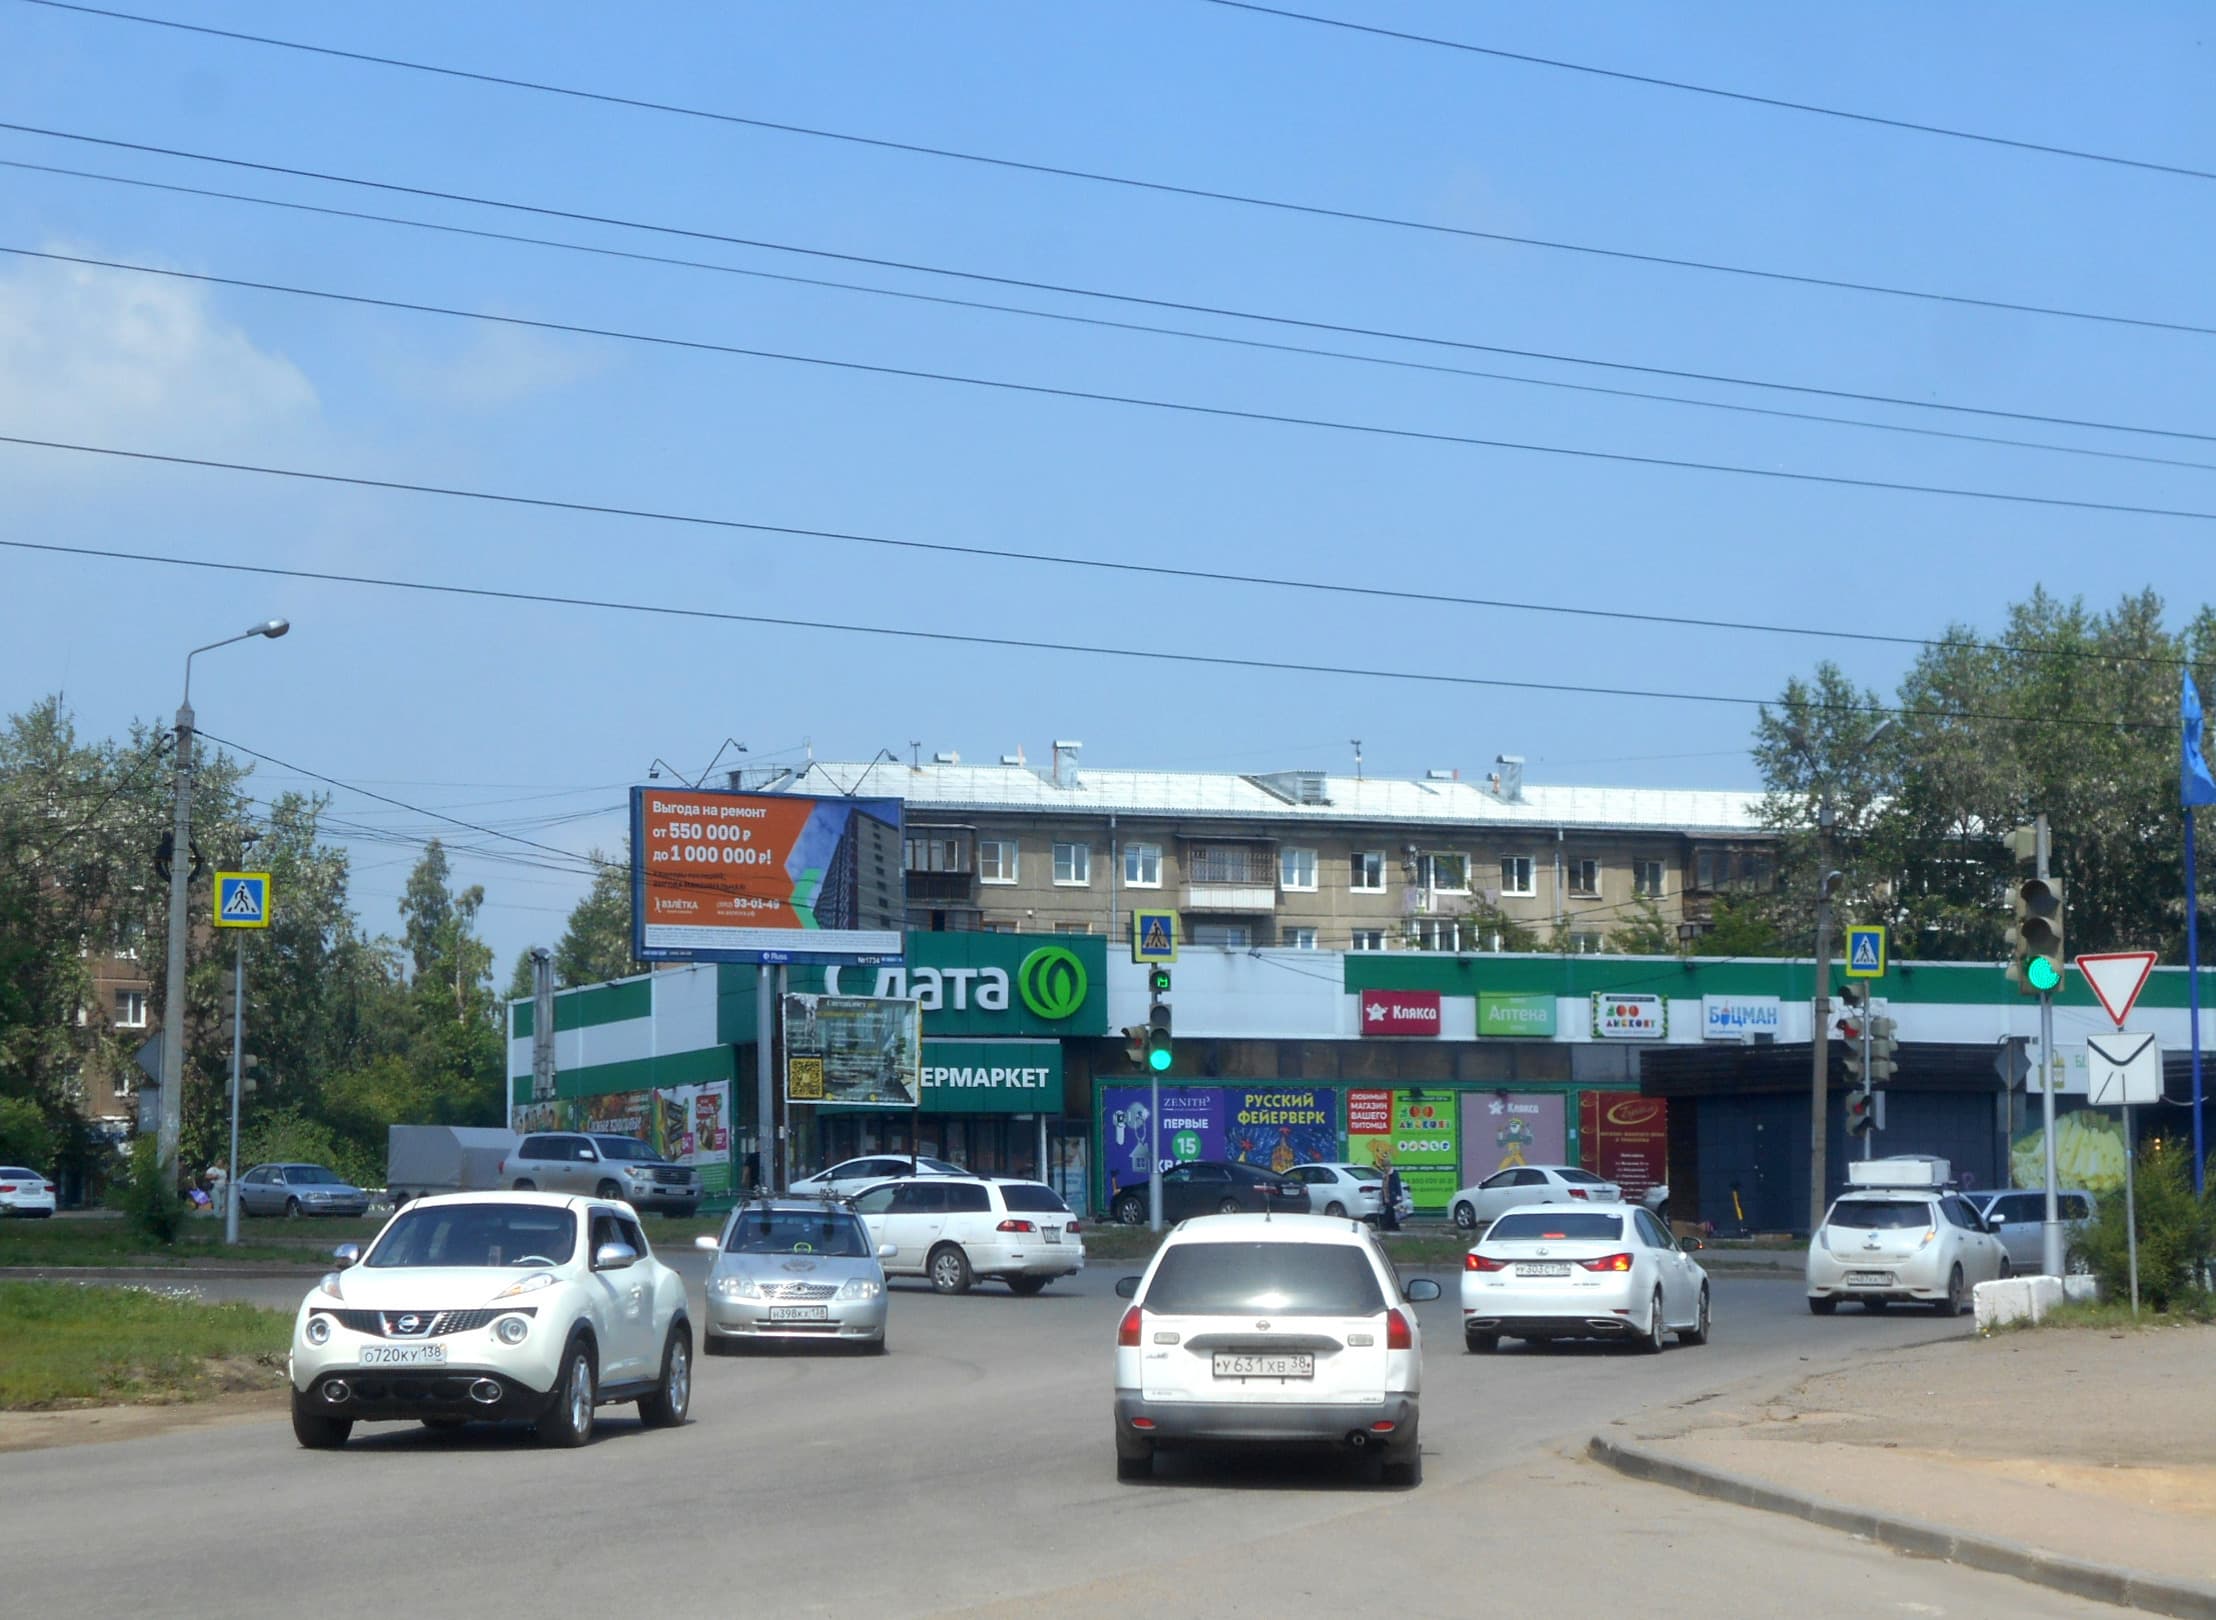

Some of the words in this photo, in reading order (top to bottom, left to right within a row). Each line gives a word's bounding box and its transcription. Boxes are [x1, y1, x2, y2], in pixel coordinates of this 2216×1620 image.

[652, 800, 700, 816] Выгода
[702, 806, 718, 816] на
[720, 808, 767, 819] ремонт
[652, 828, 667, 838] от
[669, 822, 702, 839] 550
[706, 824, 740, 841] 000
[653, 851, 668, 861] до
[671, 845, 680, 862] 1
[685, 846, 718, 863] 000
[723, 847, 756, 864] 000
[1393, 1005, 1437, 1020] Клякса
[1488, 1005, 1548, 1022] Аптека
[1245, 1092, 1315, 1108] РУССКИЙ
[1351, 1102, 1387, 1110] МАГАЗИН
[1163, 1118, 1209, 1129] ПЕРВЫЕ
[1237, 1109, 1326, 1125] ФЕЙЕРВЕРК
[1351, 1111, 1387, 1120] ВАШЕГО
[1351, 1121, 1387, 1129] ПИТОМЦА
[1177, 1138, 1197, 1154] 15
[364, 1348, 418, 1363] О720КУ
[420, 1345, 441, 1358] 138
[1222, 1357, 1286, 1374] У631ХВ
[1291, 1357, 1306, 1369] 38
